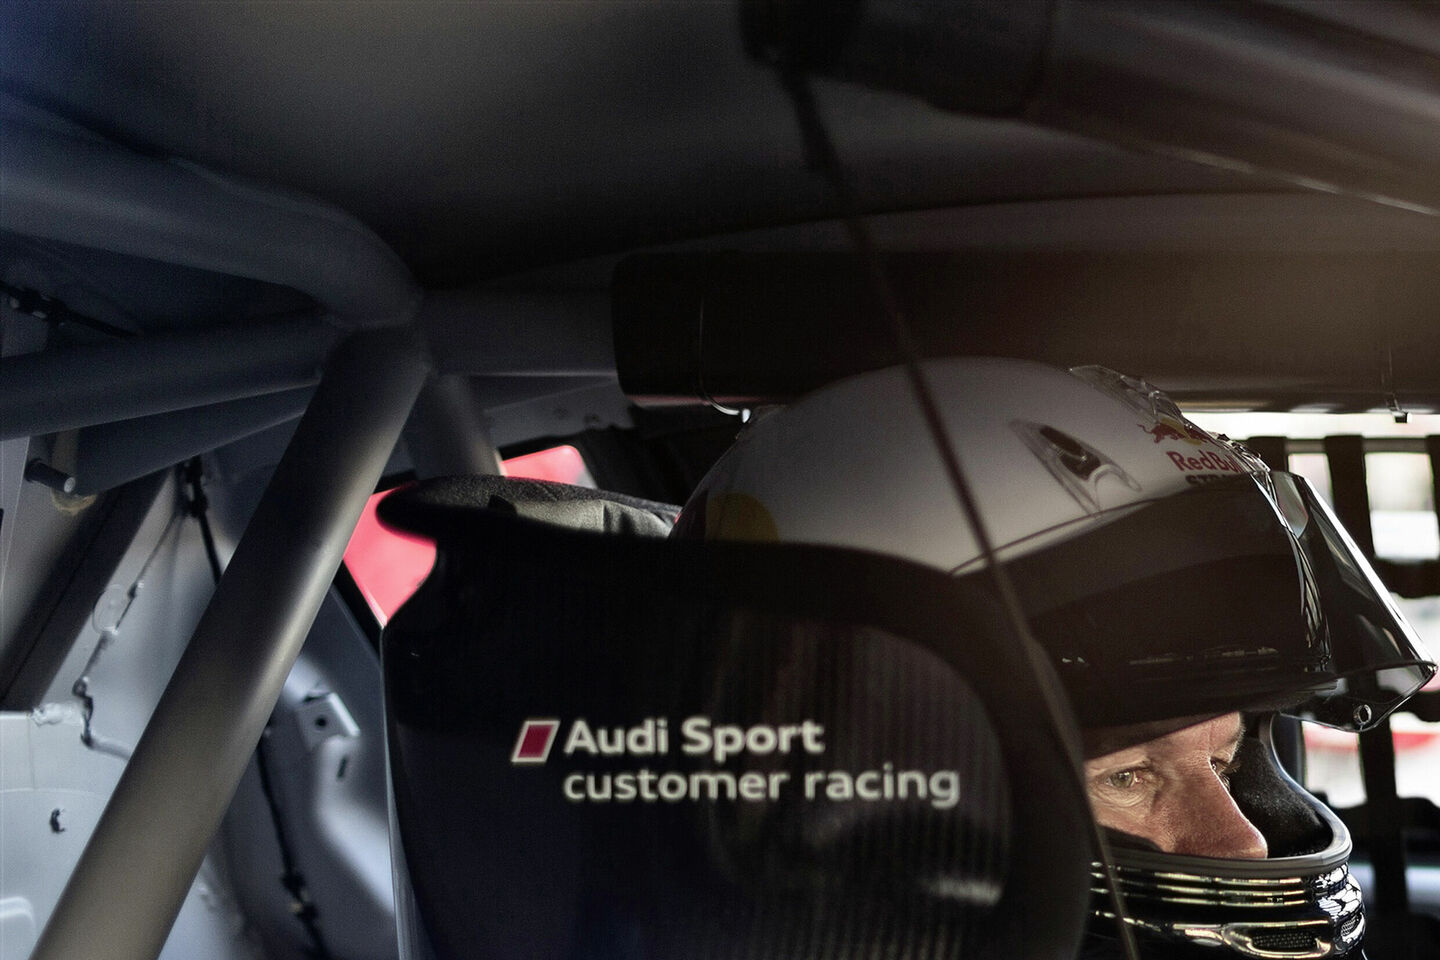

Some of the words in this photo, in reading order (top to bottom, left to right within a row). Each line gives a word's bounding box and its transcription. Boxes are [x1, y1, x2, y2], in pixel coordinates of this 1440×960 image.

[565, 720, 668, 753] Audi
[683, 718, 823, 762] Sport
[565, 770, 788, 800] customer
[805, 764, 959, 808] racing
